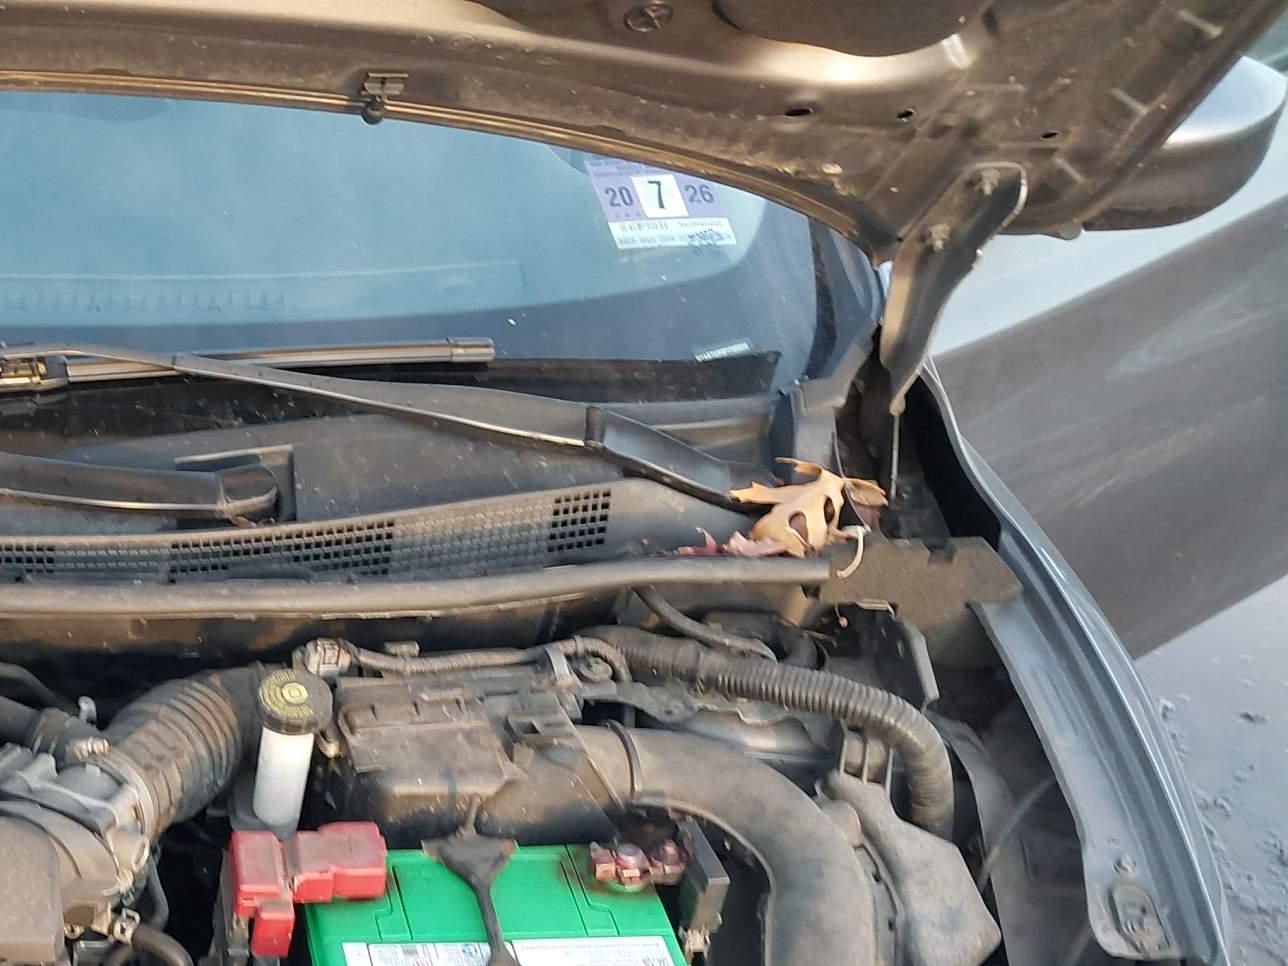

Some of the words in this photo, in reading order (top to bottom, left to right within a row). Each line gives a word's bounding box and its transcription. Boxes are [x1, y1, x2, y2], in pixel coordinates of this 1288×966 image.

[604, 186, 634, 208] 20
[647, 180, 666, 209] 7
[684, 184, 714, 204] 26
